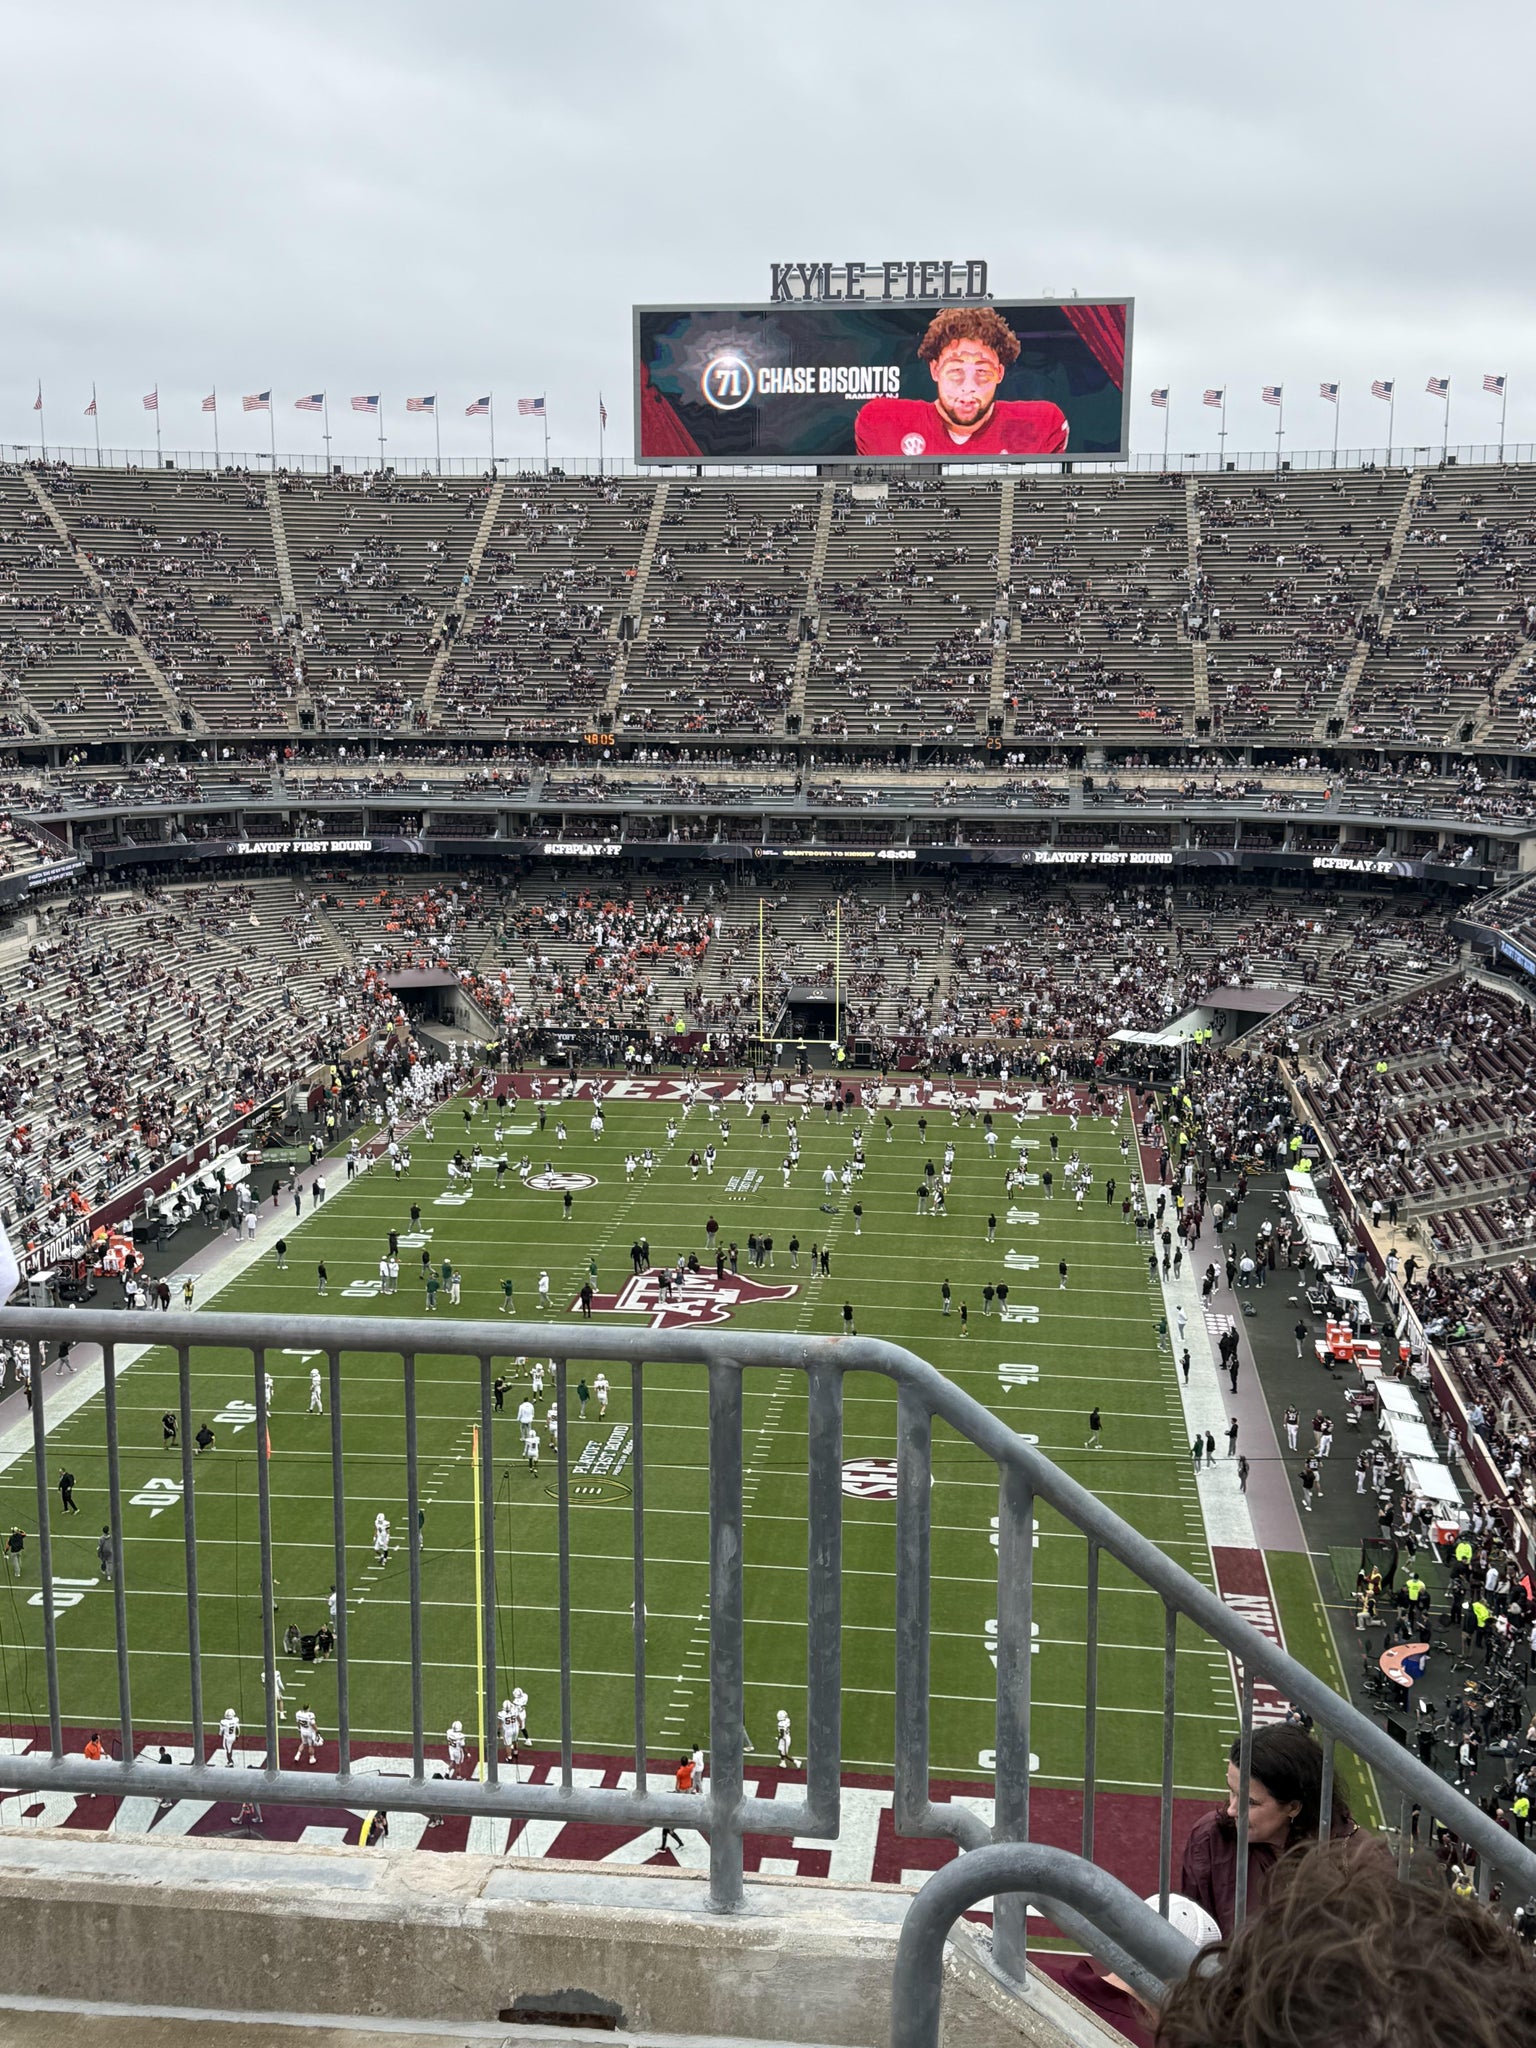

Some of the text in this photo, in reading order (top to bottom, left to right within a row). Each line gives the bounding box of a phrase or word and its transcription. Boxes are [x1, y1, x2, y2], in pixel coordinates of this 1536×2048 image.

[770, 260, 987, 301] KYLE FIELD
[715, 366, 900, 397] 71 CHASE BISONTIS
[988, 738, 1001, 749] 25
[238, 840, 372, 854] PLAYOFF FIRST ROUND
[1035, 852, 1173, 864] PLAYOFF FIRST ROUND
[547, 1079, 836, 1107] TEXAS
[1006, 1211, 1040, 1225] 30
[1004, 1254, 1040, 1271] 40
[1001, 1304, 1040, 1323] 50
[998, 1363, 1040, 1385] 40
[604, 1425, 630, 1452] ROUND
[572, 1440, 603, 1474] PLAYOFF
[129, 1477, 195, 1507] 20
[27, 1577, 100, 1607] 10
